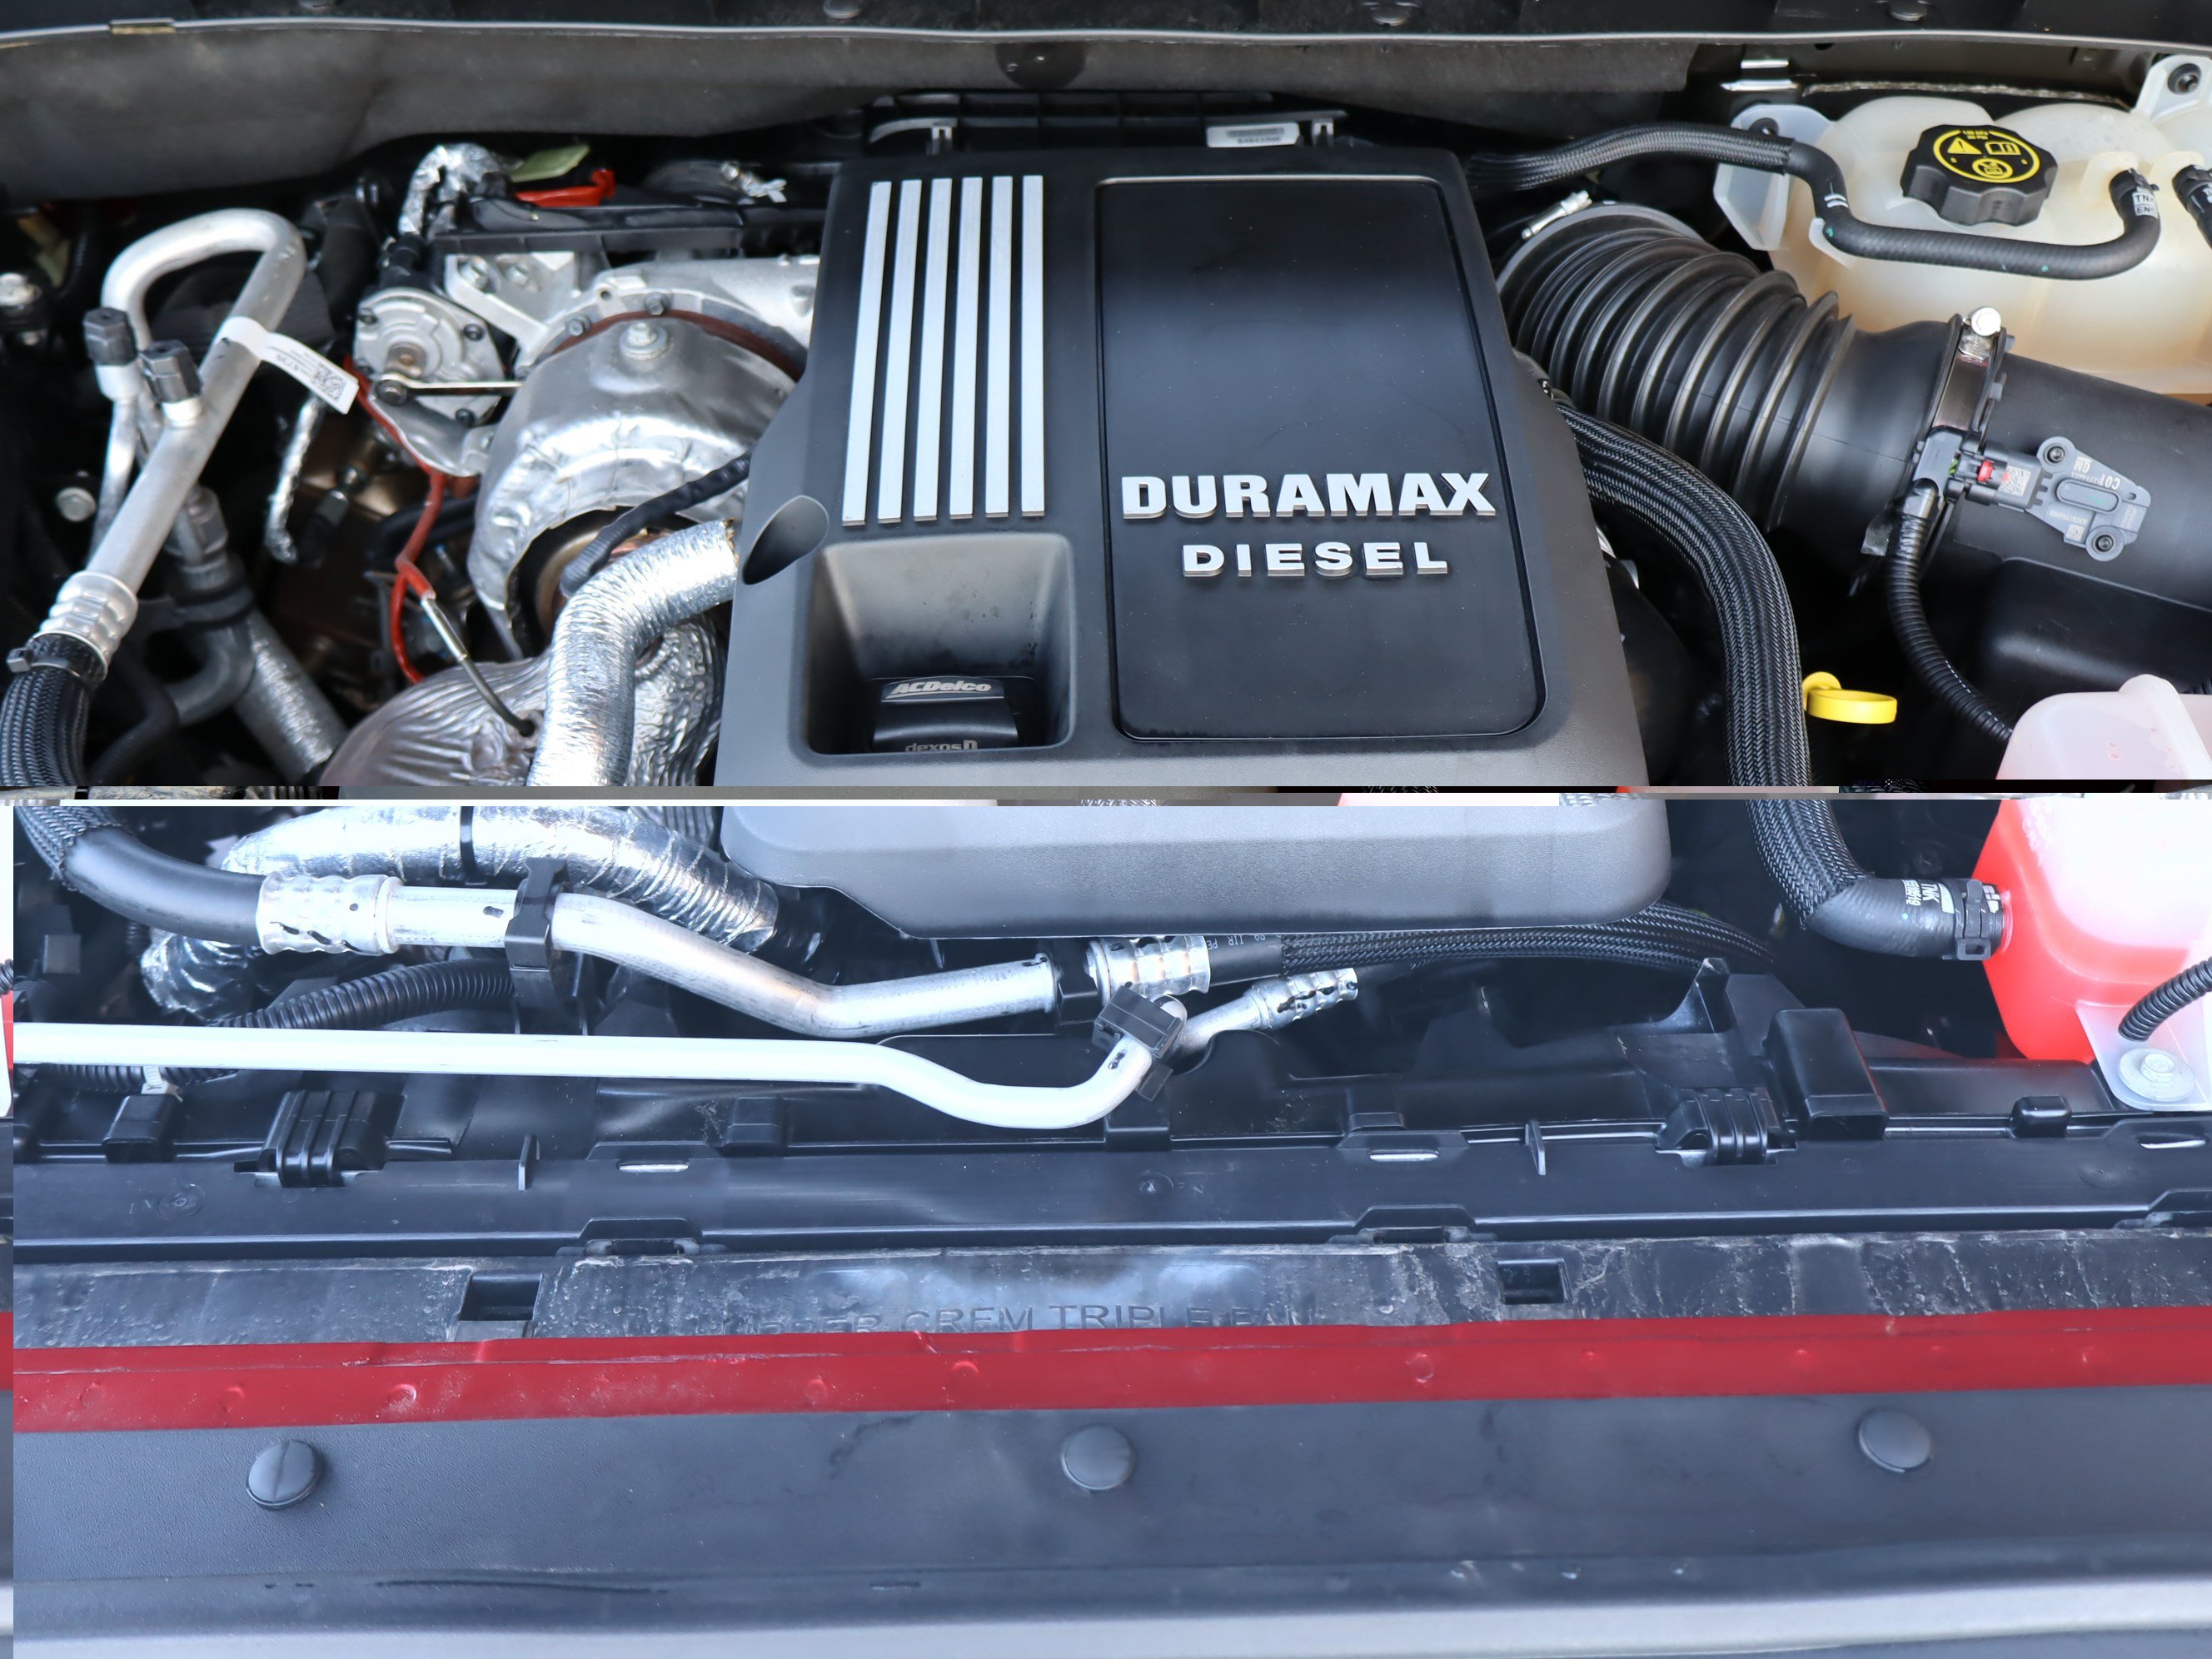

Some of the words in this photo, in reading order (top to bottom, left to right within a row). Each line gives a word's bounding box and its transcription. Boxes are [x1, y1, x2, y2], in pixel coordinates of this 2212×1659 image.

[2073, 459, 2090, 474] GM
[1122, 472, 1497, 520] DURAMAX
[1182, 542, 1448, 577] DIESEL
[889, 680, 992, 695] ACDelco
